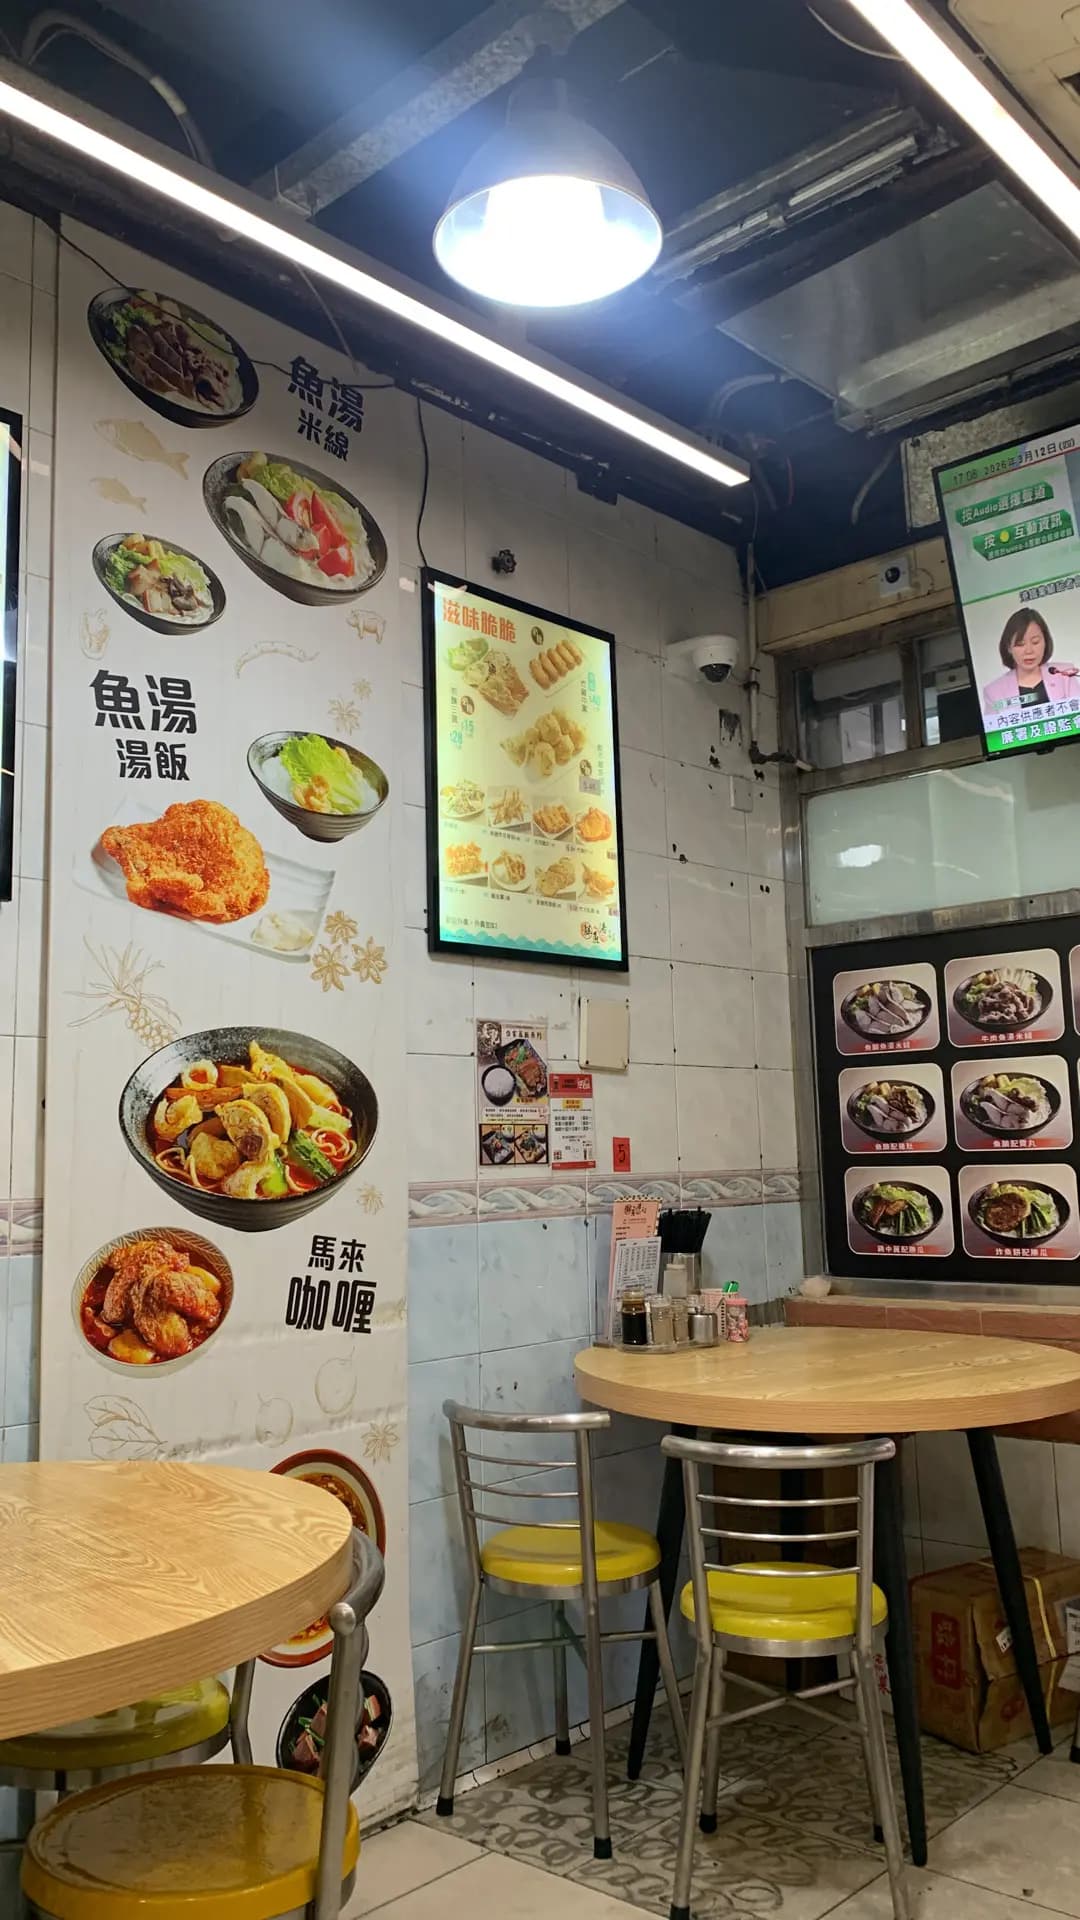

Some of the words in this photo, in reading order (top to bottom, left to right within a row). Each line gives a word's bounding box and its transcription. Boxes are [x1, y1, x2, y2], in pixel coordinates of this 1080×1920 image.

[287, 356, 364, 434] 魚湯
[297, 411, 349, 462] 米線
[983, 534, 996, 550] 按
[443, 597, 516, 643] 滋味脆脆
[89, 669, 198, 735] 魚湯
[116, 739, 190, 781] 湯飯
[618, 1144, 626, 1162] 5
[307, 1234, 368, 1273] 馬來
[285, 1275, 377, 1335] 咖喱
